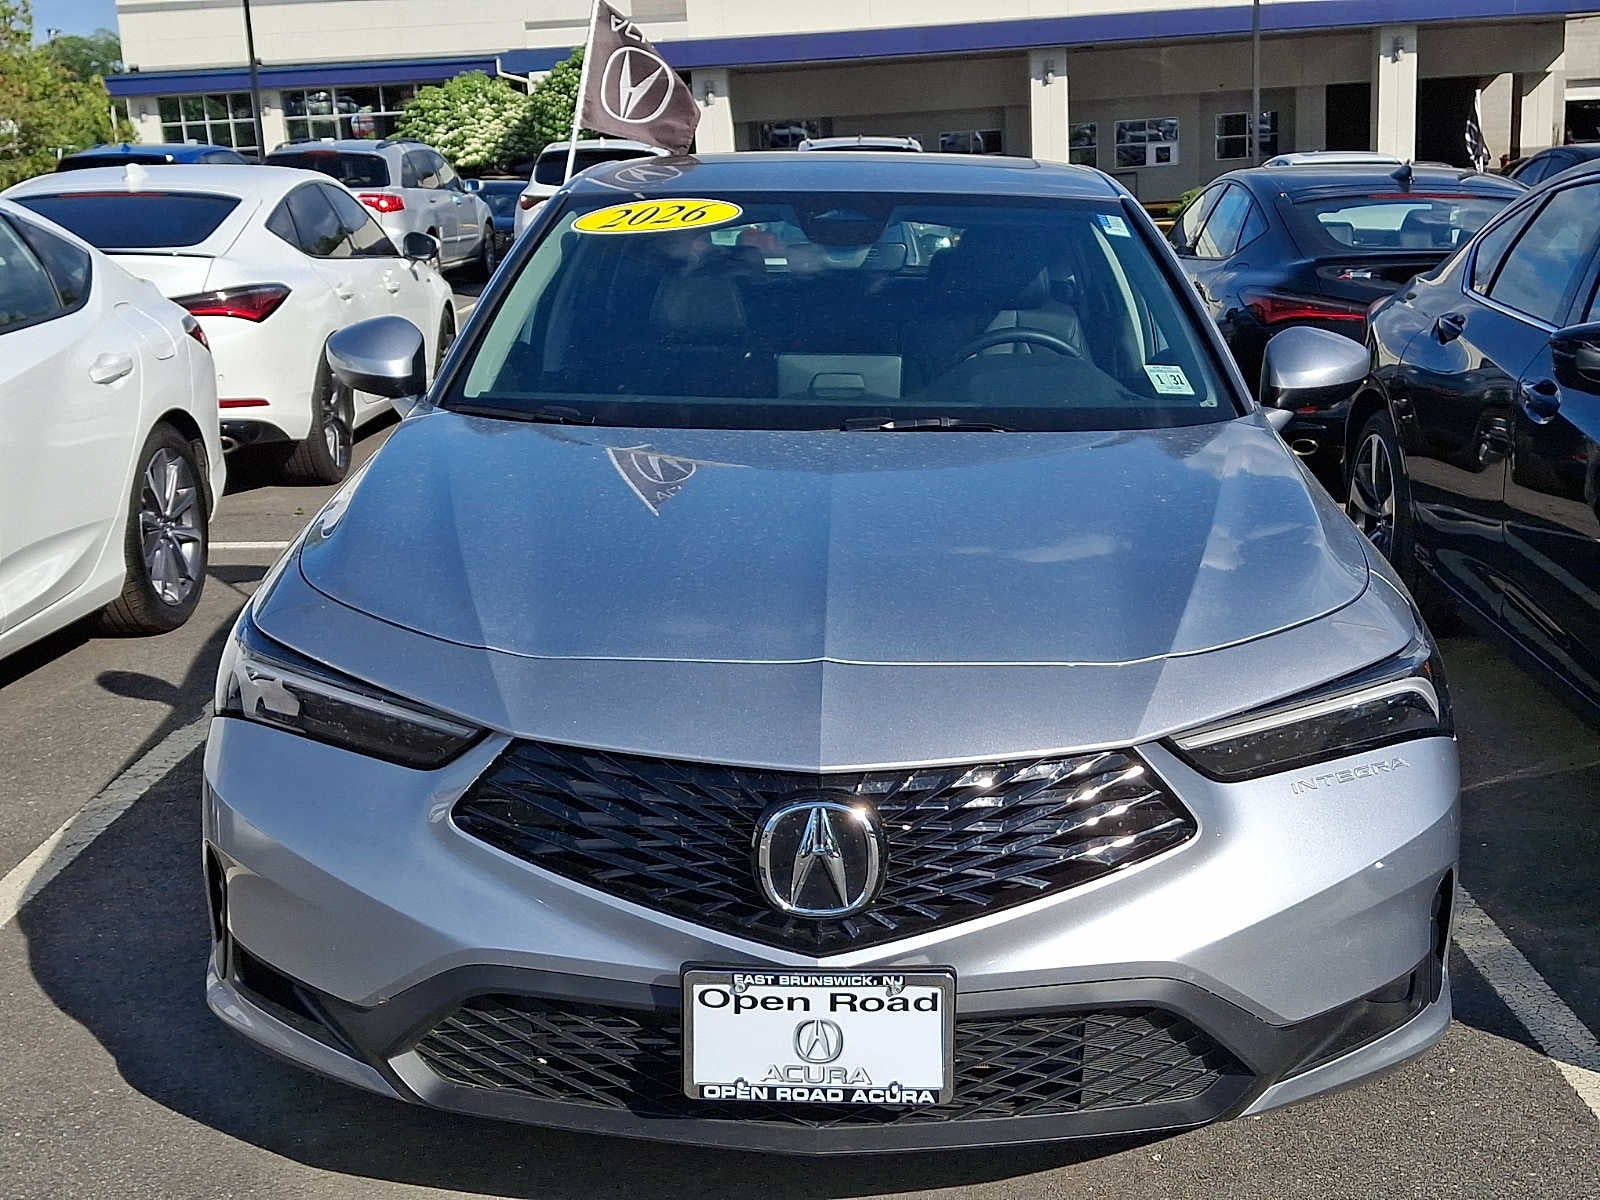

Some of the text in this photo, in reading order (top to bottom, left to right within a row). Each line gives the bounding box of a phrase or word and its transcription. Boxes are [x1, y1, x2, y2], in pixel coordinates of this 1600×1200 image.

[597, 204, 716, 229] 2026
[1155, 373, 1185, 386] 1 31
[1290, 757, 1410, 795] INTEGRA
[733, 973, 904, 987] EAST BRUNSWICK, NJ
[698, 988, 938, 1014] Open Road
[760, 1064, 873, 1085] ACURA
[703, 1085, 936, 1104] OPEN ROAD ACURA
